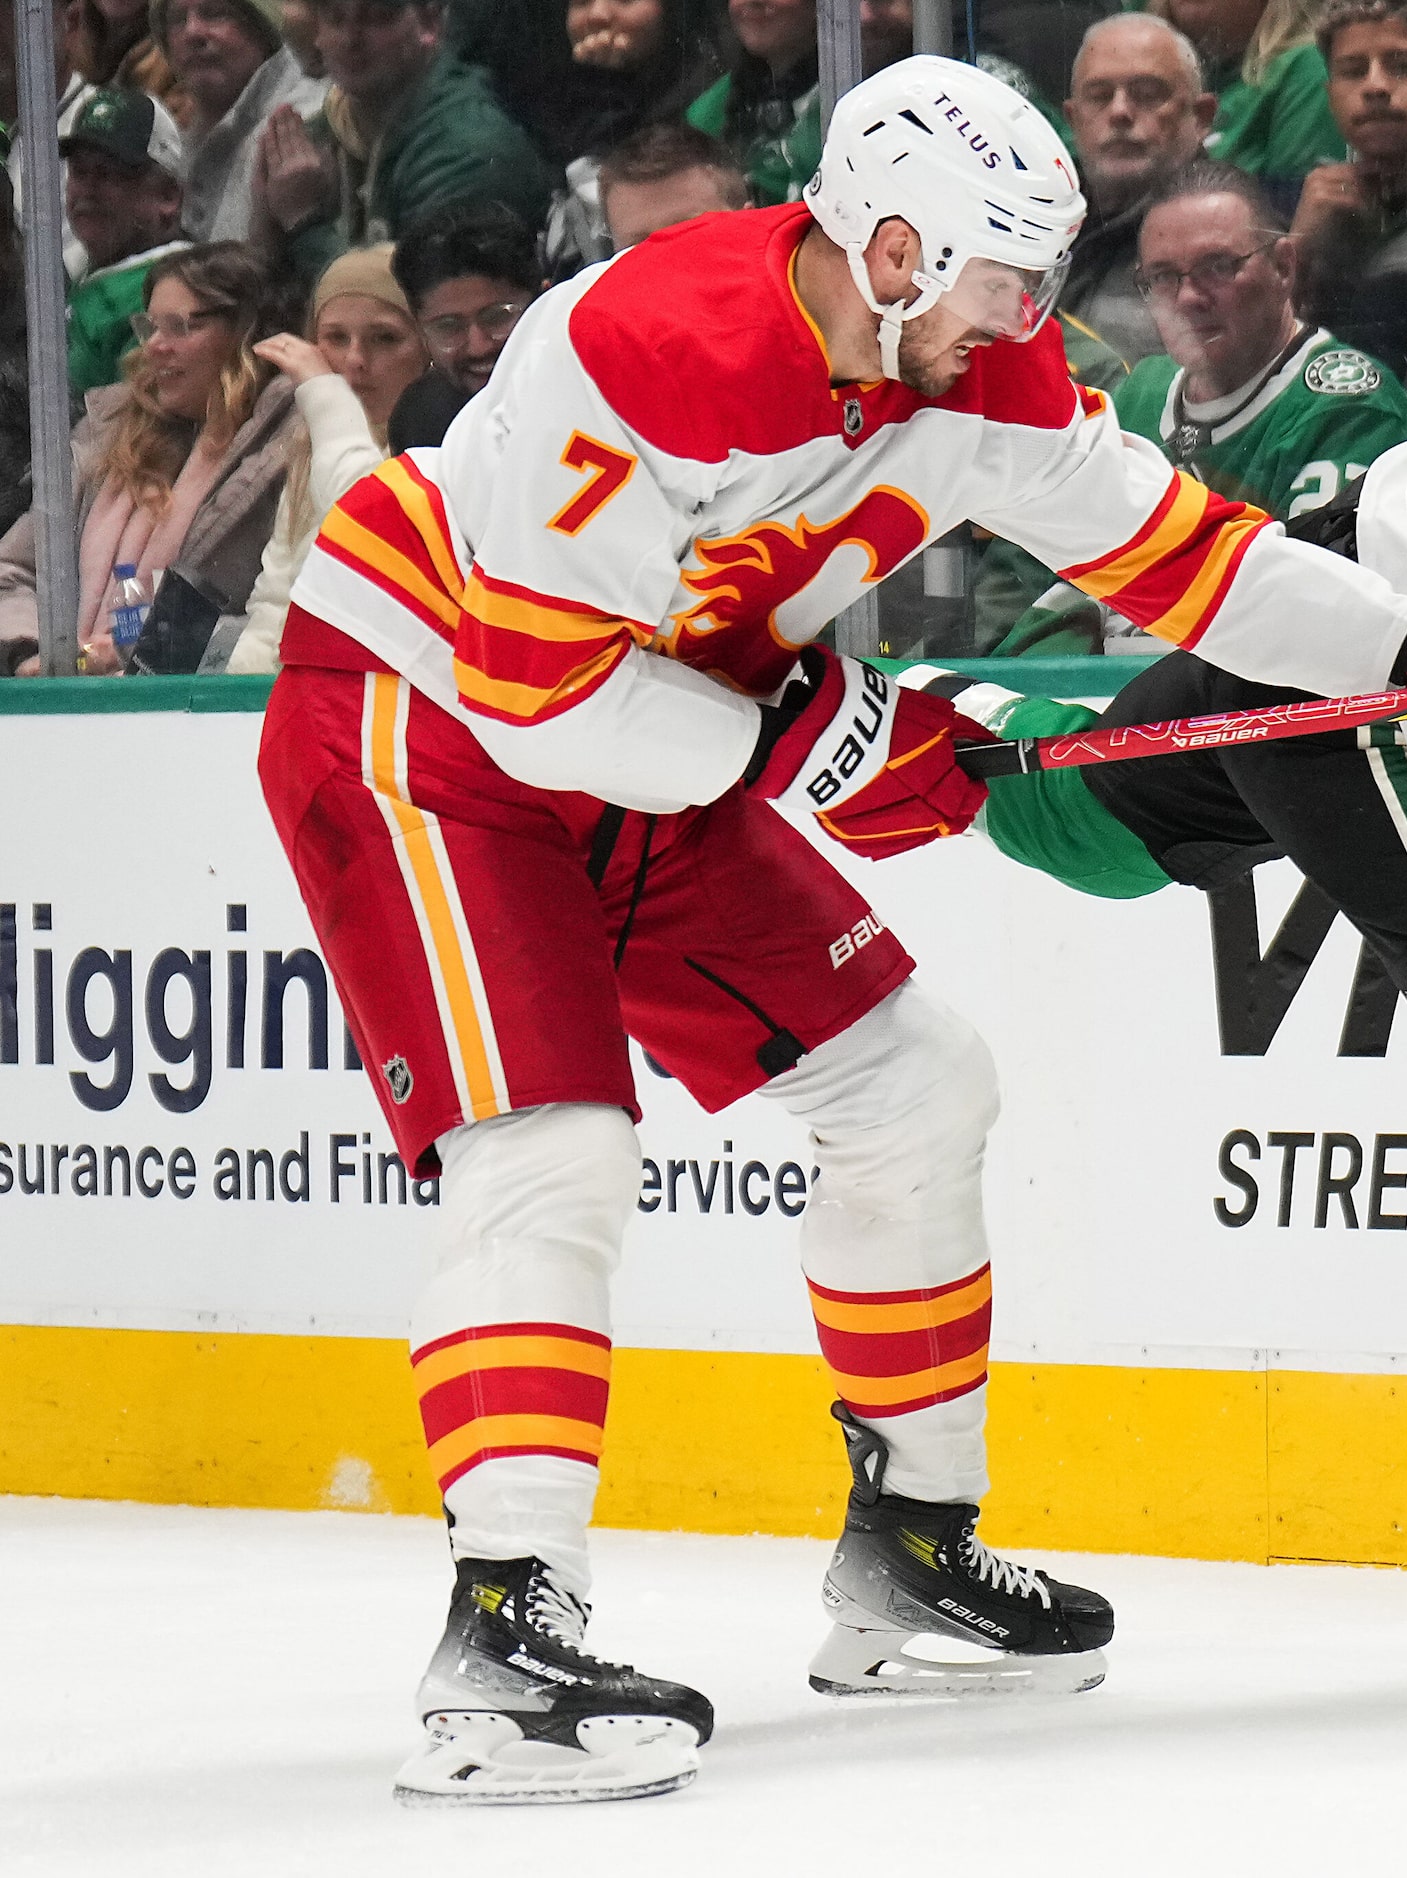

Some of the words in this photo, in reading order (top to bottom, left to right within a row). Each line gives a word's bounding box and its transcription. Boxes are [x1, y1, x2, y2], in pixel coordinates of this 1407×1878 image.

[933, 91, 1002, 169] TELUS
[545, 428, 639, 538] 7
[879, 641, 890, 655] 14
[1189, 726, 1269, 748] BAUER
[828, 911, 885, 971] BAU
[213, 1130, 310, 1203] and
[638, 1140, 821, 1218] ervice
[937, 1597, 1010, 1639] BAUER
[505, 1651, 579, 1687] BAUER
